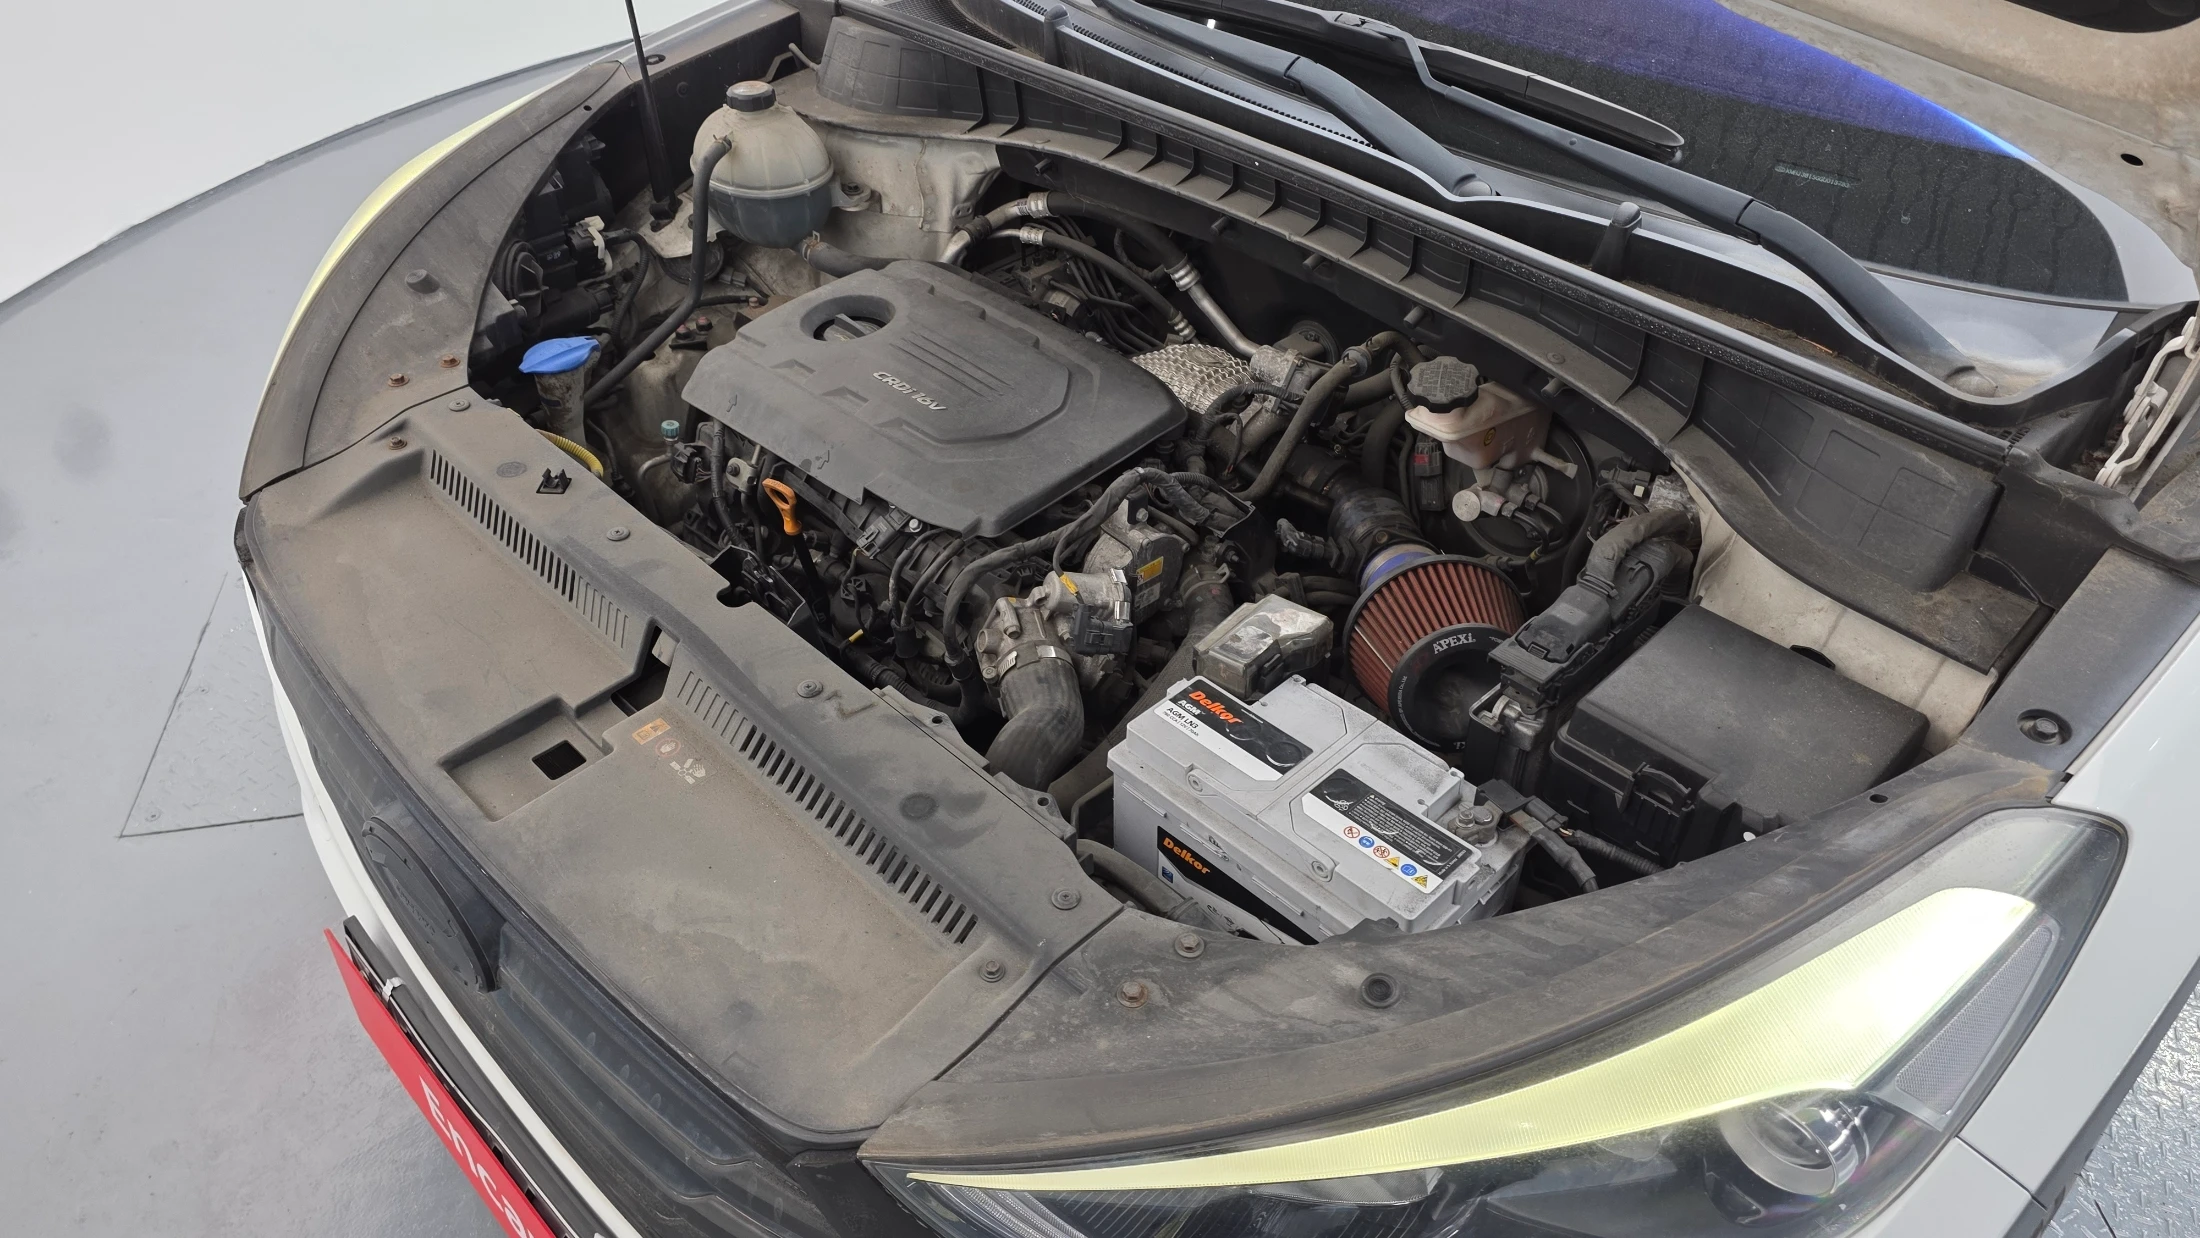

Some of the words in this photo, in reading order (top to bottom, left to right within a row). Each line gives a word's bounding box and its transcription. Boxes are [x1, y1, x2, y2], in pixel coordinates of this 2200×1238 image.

[873, 371, 917, 394] CRDi
[911, 392, 947, 410] 16V
[1166, 707, 1186, 721] AGM
[1184, 718, 1199, 729] LN3
[1177, 699, 1202, 716] AGM
[1188, 690, 1244, 724] Delkor
[1163, 837, 1211, 874] Delkor
[419, 1075, 536, 1238] Enca
